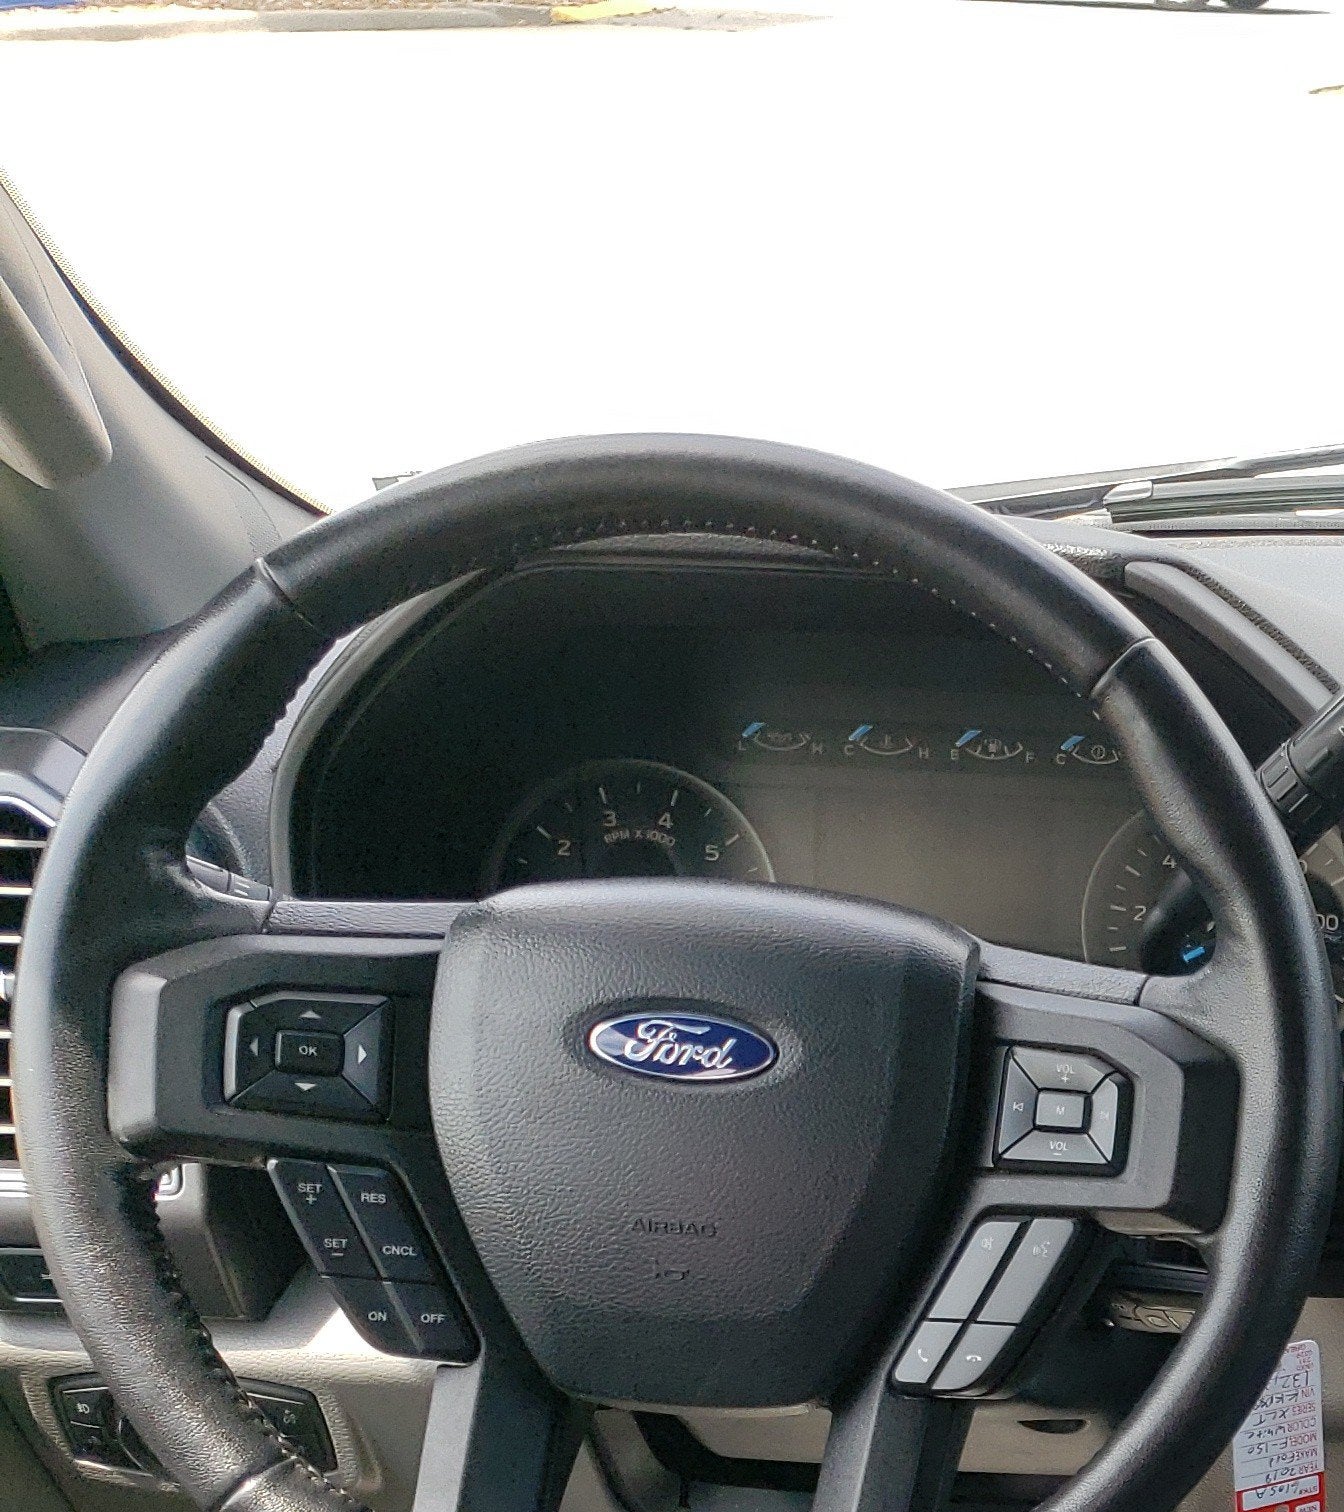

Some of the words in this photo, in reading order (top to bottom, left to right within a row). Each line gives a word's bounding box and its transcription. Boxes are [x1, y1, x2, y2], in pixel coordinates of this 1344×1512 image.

[603, 810, 617, 827] 3
[658, 811, 674, 829] 4
[558, 839, 571, 856] 2
[704, 844, 720, 861] 5
[624, 1018, 737, 1069] Ford
[298, 1045, 318, 1057] OK
[1056, 1063, 1076, 1075] VOL
[1049, 1140, 1069, 1151] VOL
[298, 1183, 322, 1193] SET
[360, 1193, 387, 1204] RES
[324, 1238, 348, 1249] SET
[382, 1245, 418, 1257] CNCL
[368, 1311, 387, 1322] ON
[421, 1313, 446, 1325] OFF
[1247, 1437, 1288, 1455] F-150
